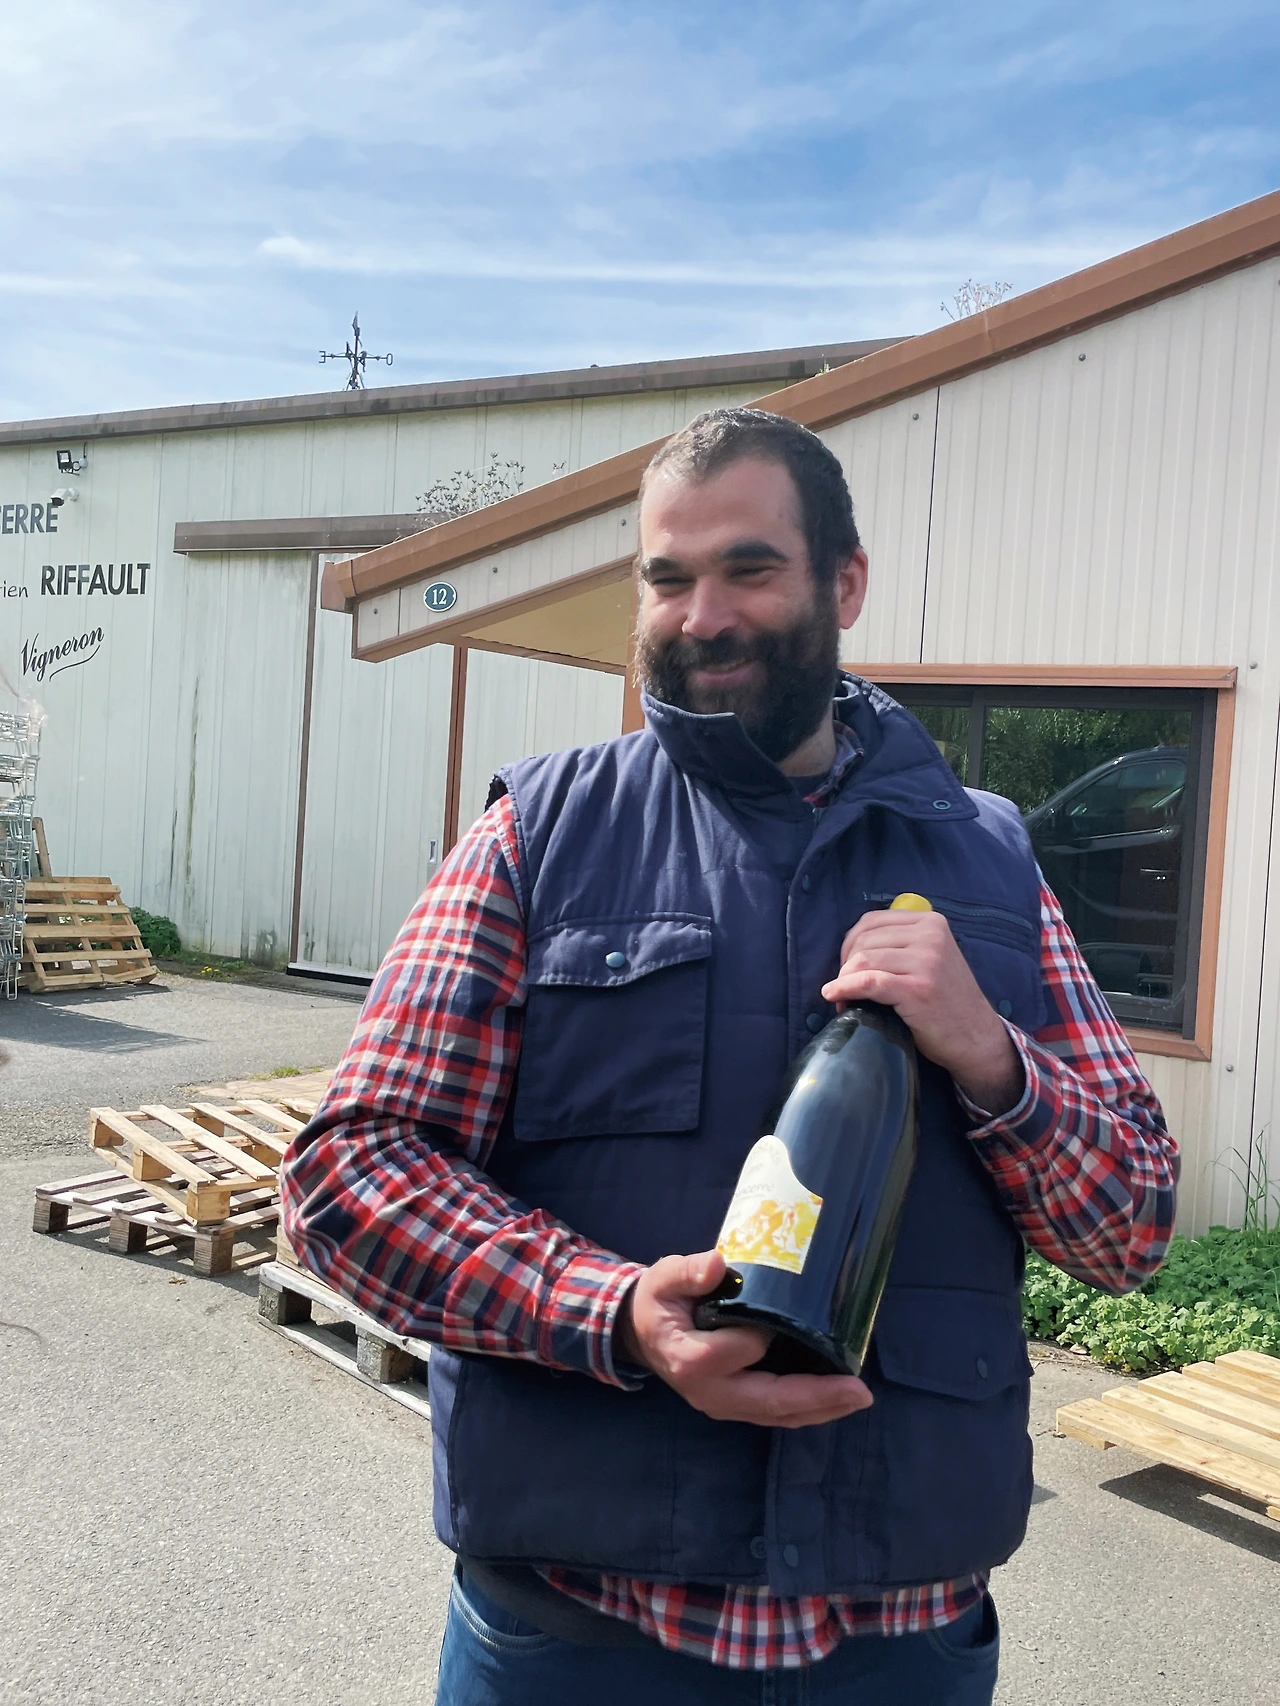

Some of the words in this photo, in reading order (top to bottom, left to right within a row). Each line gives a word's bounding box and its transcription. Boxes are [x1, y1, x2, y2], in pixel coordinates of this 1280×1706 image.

[0, 502, 58, 534] ERRE
[40, 563, 151, 596] RIFFAULT
[432, 588, 447, 605] 12
[21, 626, 105, 682] Vigneron
